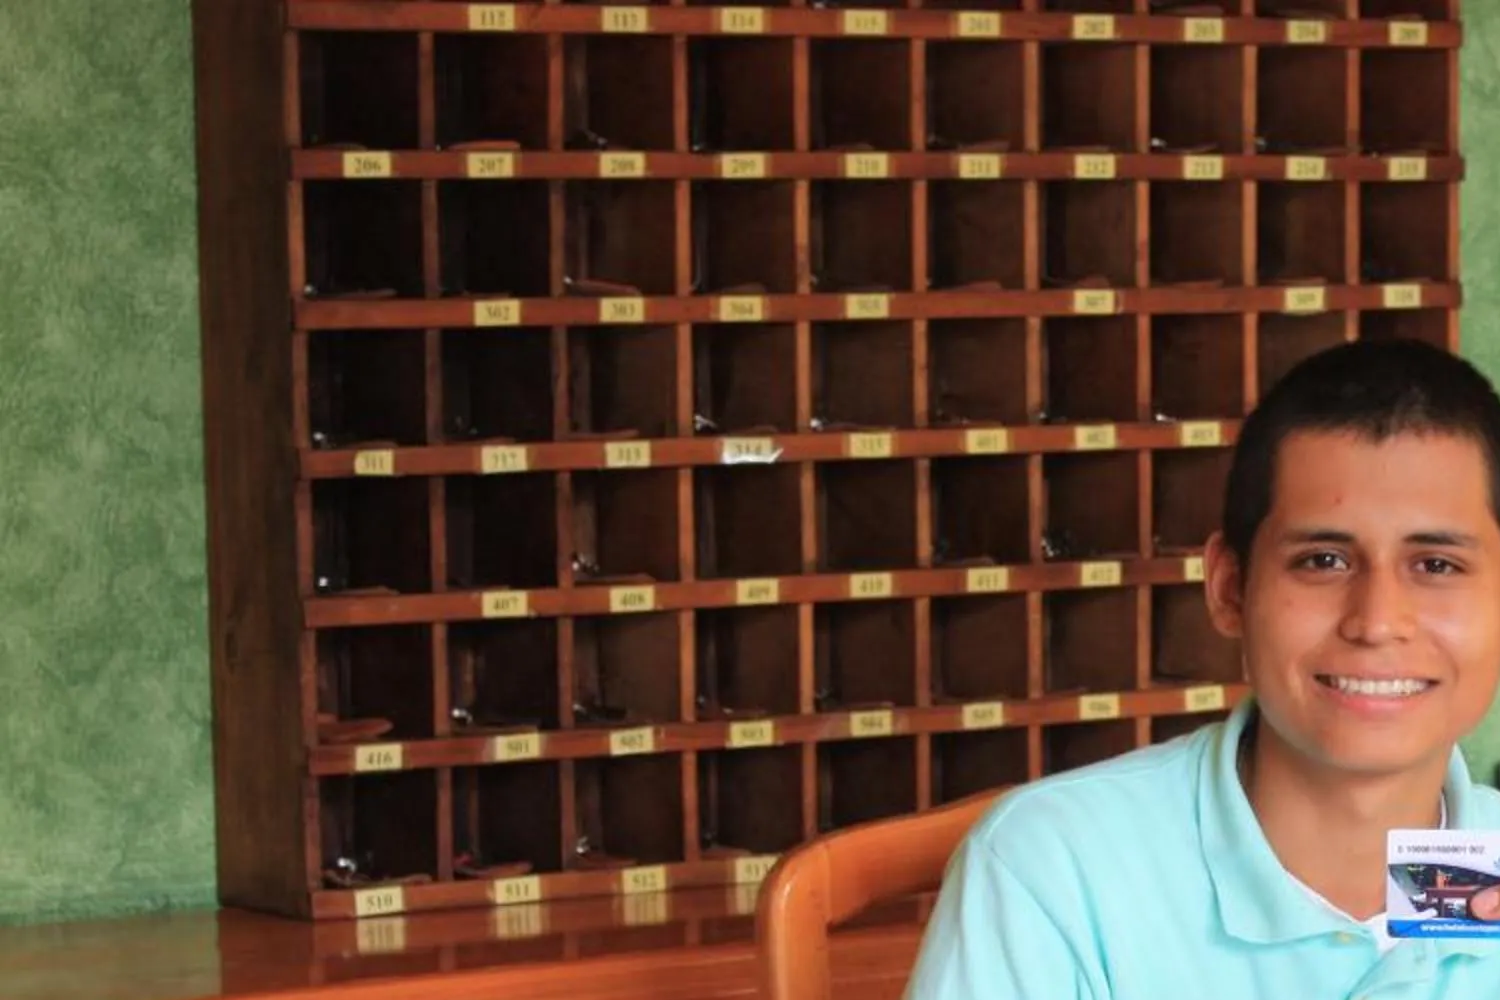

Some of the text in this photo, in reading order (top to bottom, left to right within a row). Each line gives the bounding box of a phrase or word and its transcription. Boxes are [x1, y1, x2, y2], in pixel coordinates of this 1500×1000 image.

[481, 10, 506, 26] 112
[354, 157, 382, 174] 206
[479, 157, 504, 173] 207
[610, 158, 636, 174] 208
[486, 305, 511, 321] 302
[493, 595, 519, 611] 407
[620, 592, 646, 607] 408
[366, 751, 393, 767] 416
[632, 872, 657, 889] 512
[505, 882, 530, 898] 511
[367, 893, 394, 910] 510
